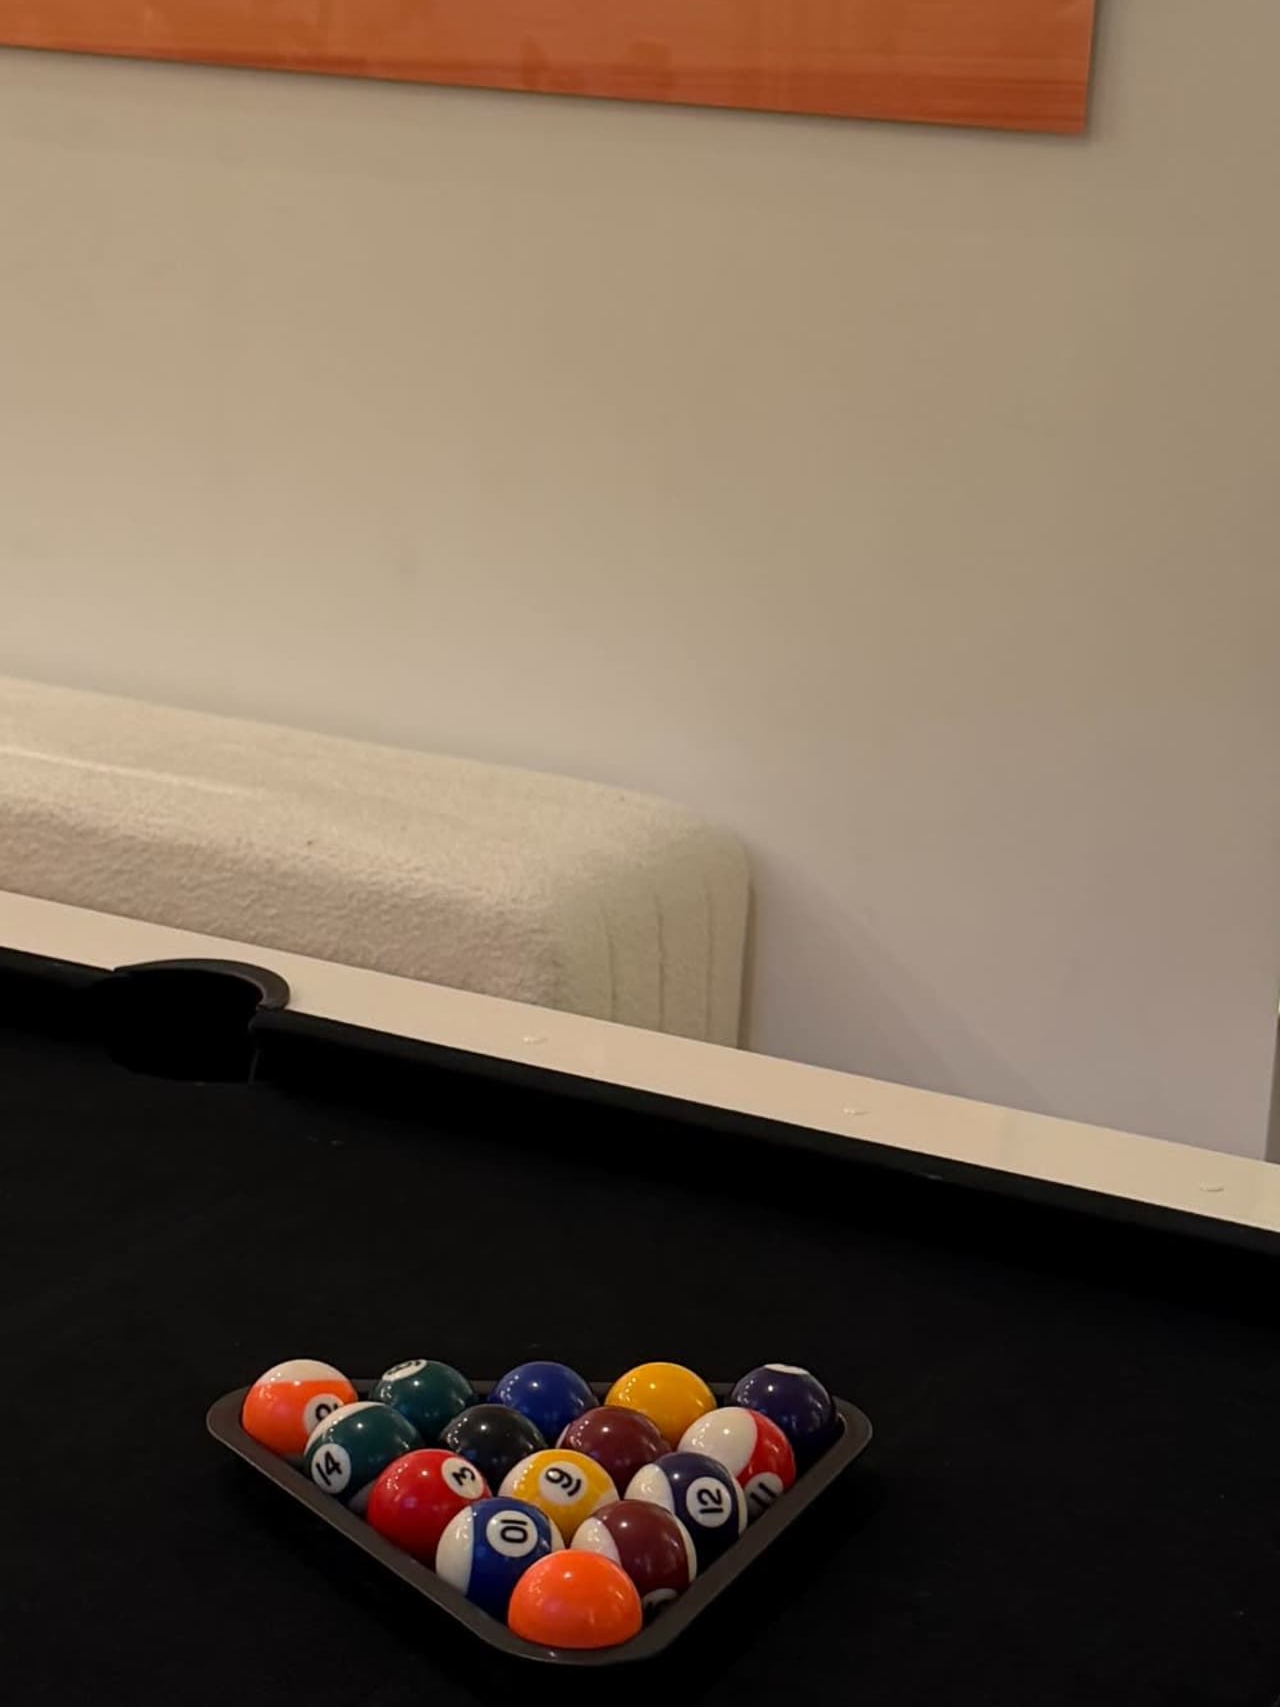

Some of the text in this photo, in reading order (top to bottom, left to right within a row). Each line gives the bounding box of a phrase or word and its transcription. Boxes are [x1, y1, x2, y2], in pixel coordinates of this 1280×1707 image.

[315, 1450, 343, 1487] 14
[451, 1466, 476, 1487] 3
[697, 1487, 725, 1515] 12
[499, 1518, 529, 1545] 10
